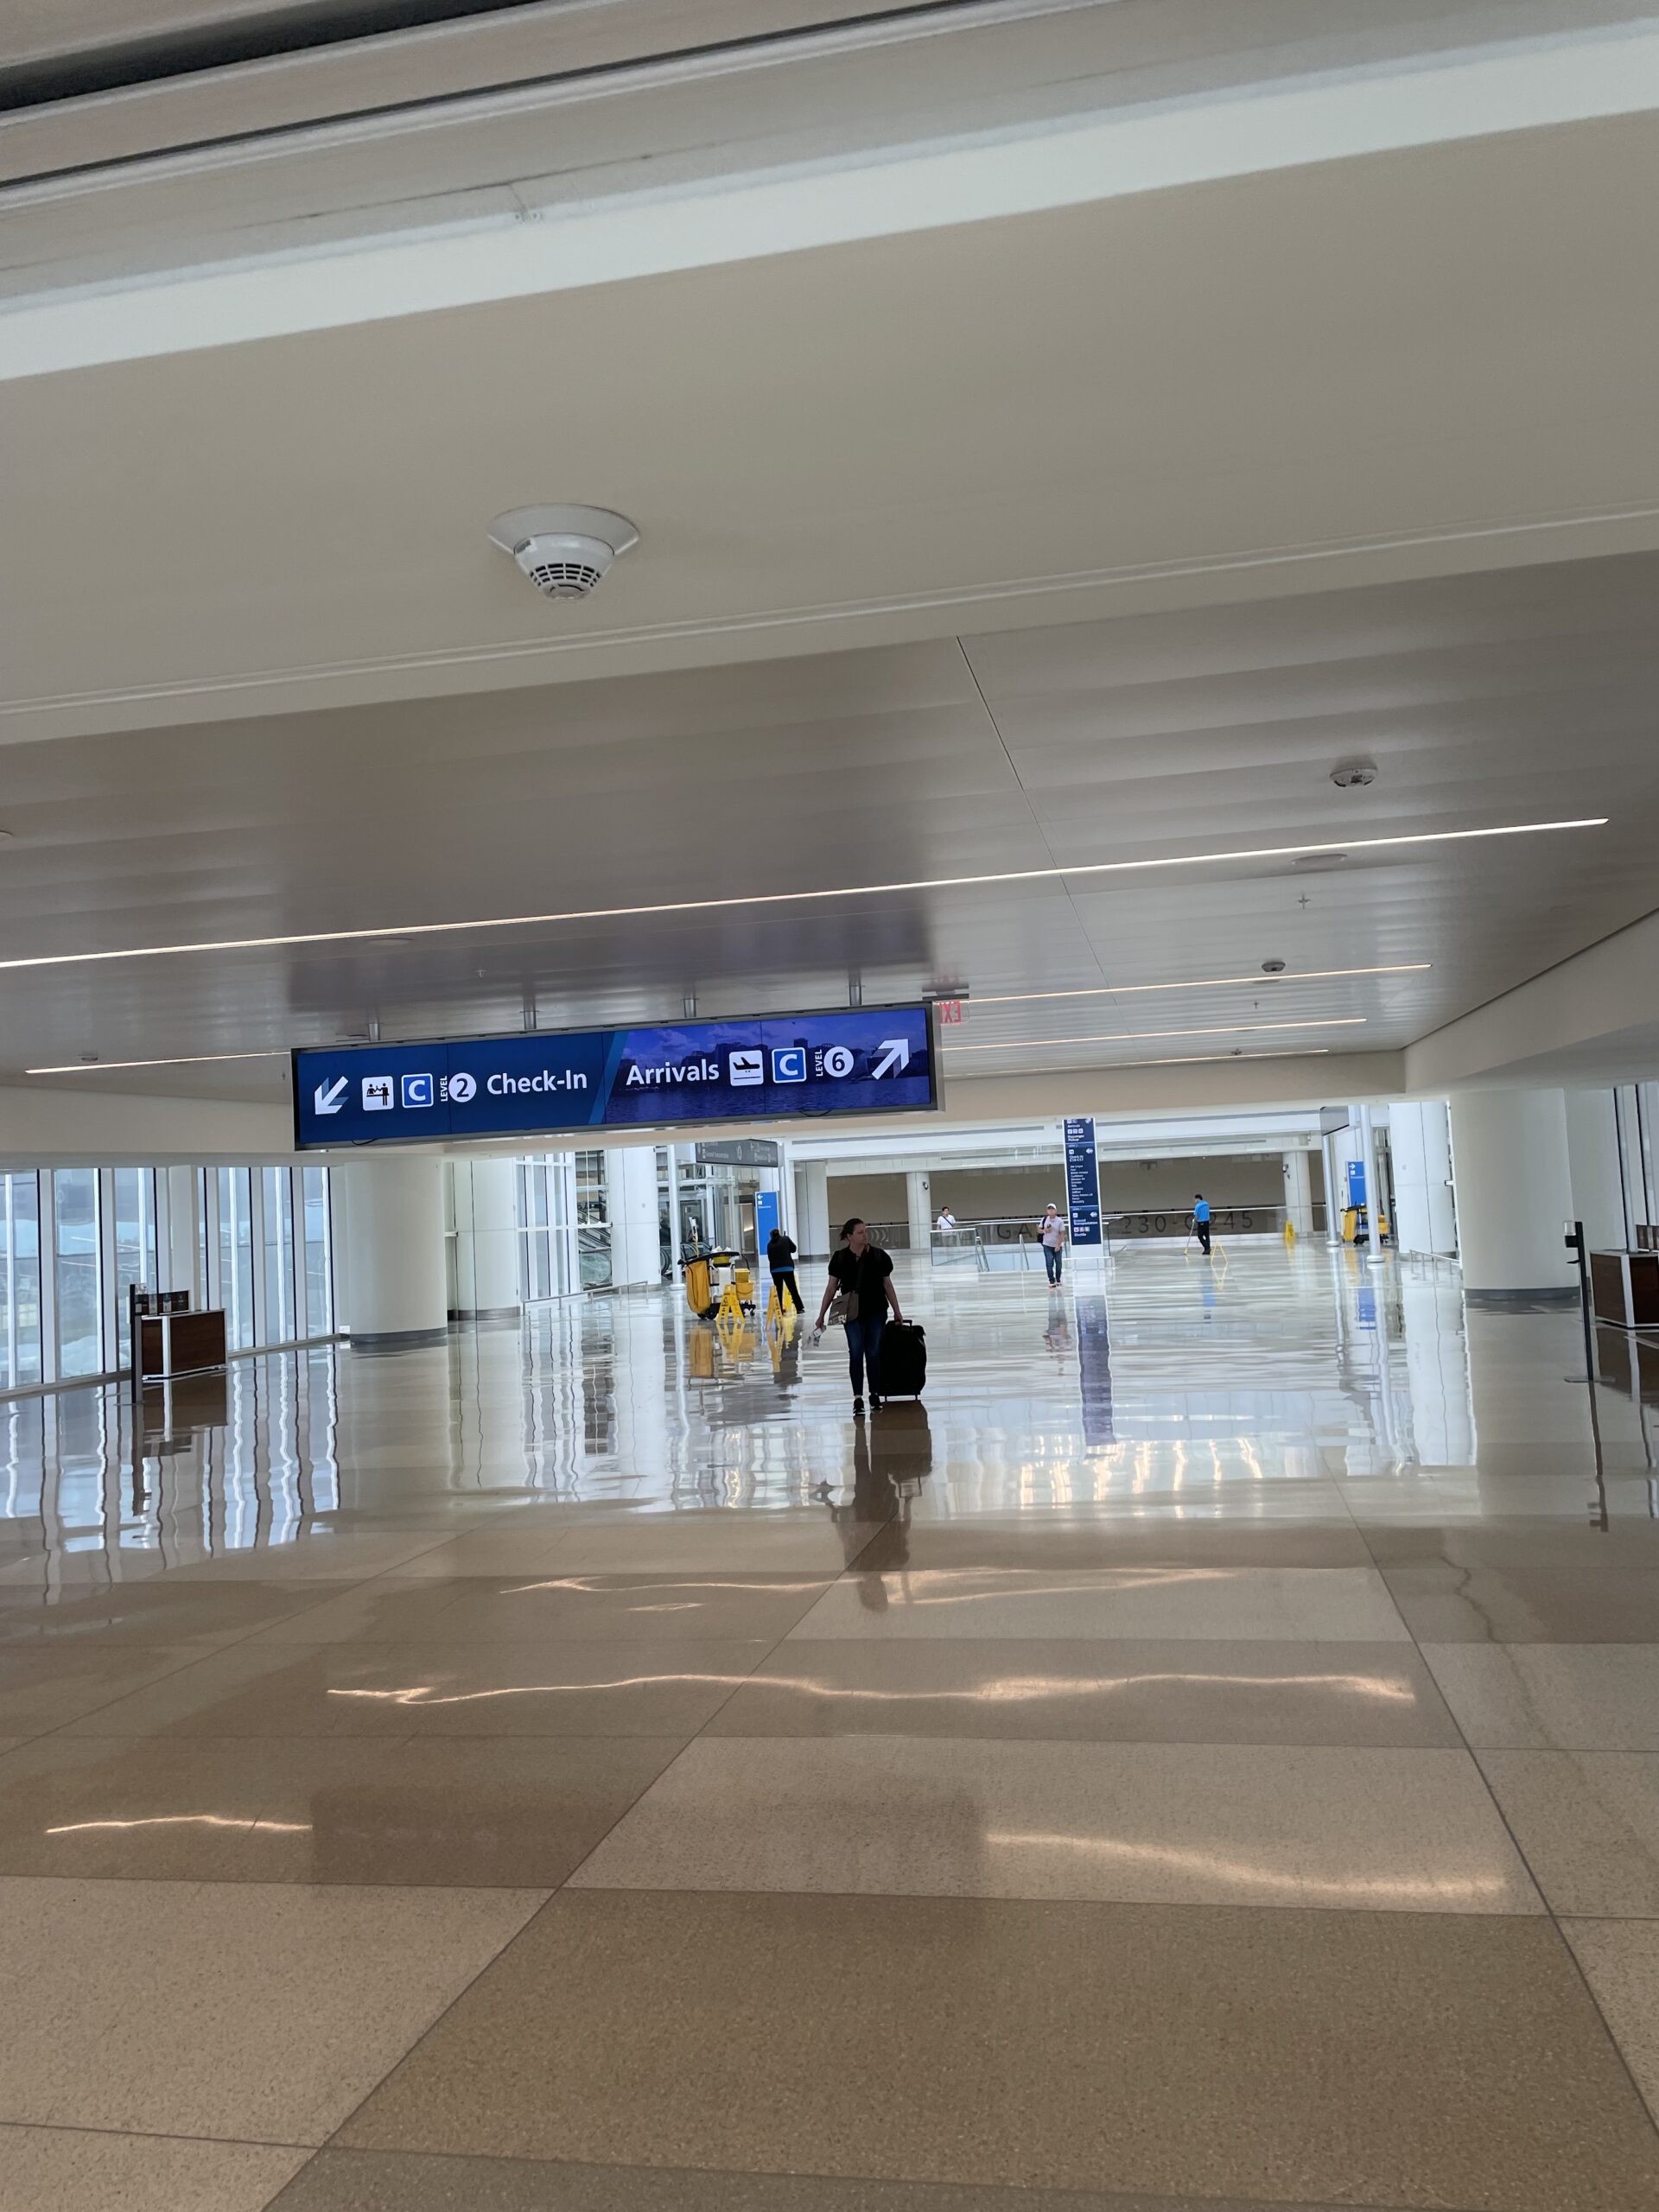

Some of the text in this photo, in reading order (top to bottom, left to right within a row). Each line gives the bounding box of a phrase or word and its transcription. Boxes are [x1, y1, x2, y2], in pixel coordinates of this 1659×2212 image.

[626, 1058, 720, 1085] Arrivals
[779, 1053, 798, 1076] C
[832, 1052, 845, 1071] 6
[408, 1070, 588, 1102] C LEVEL 2 Check-In
